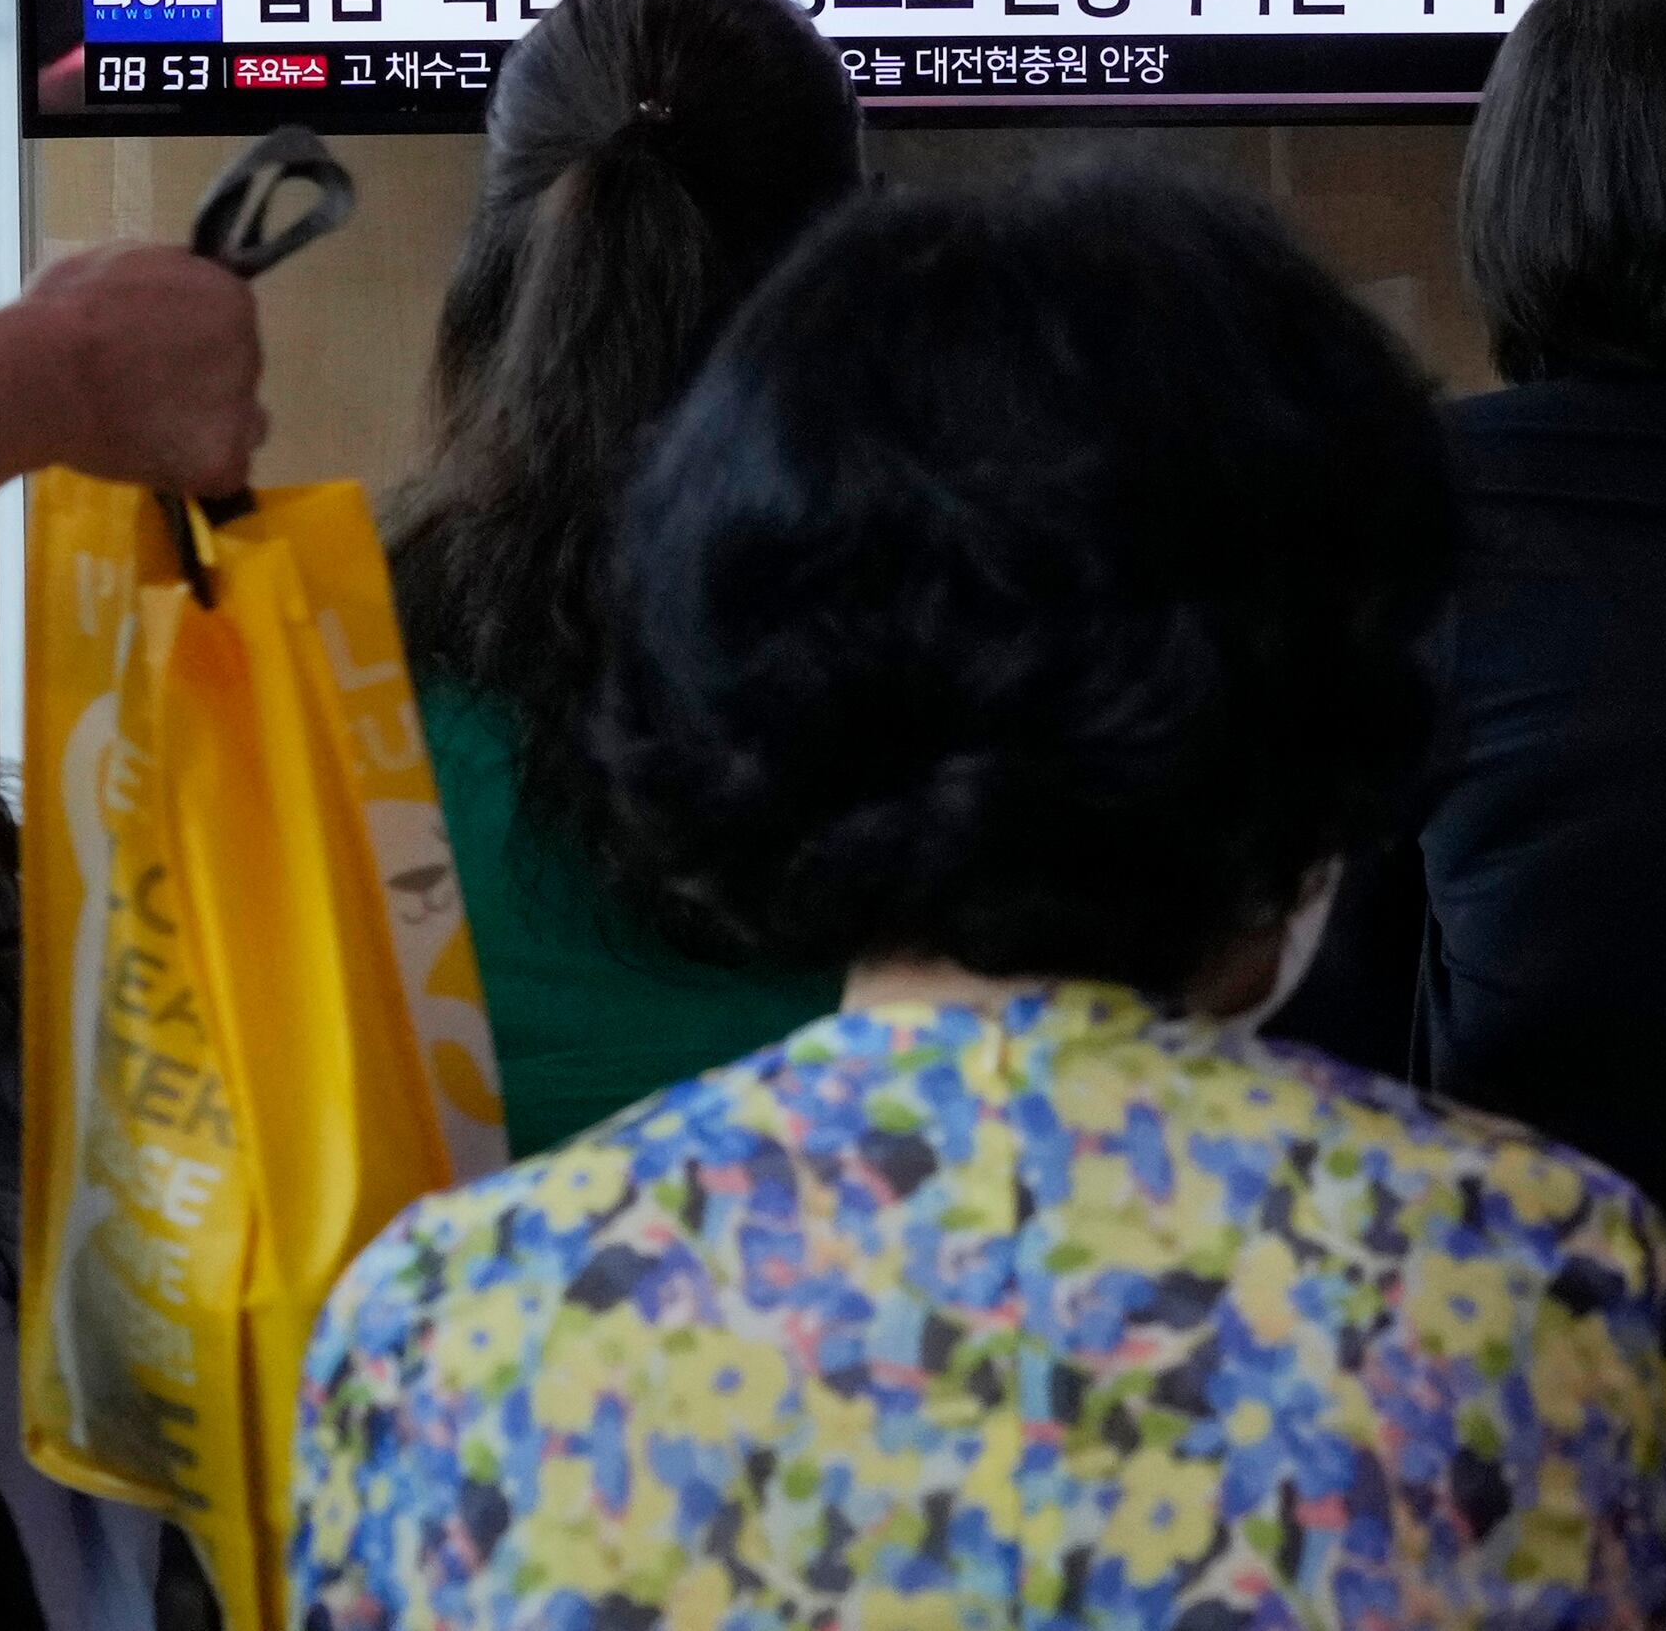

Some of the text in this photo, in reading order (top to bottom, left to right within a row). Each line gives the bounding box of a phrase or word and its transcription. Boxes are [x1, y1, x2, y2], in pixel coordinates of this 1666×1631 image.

[96, 8, 213, 20] NEWS WIDE
[236, 59, 326, 86] 주요뉴스
[340, 44, 1169, 89] 고 채수근 오늘 대전현충원 안장
